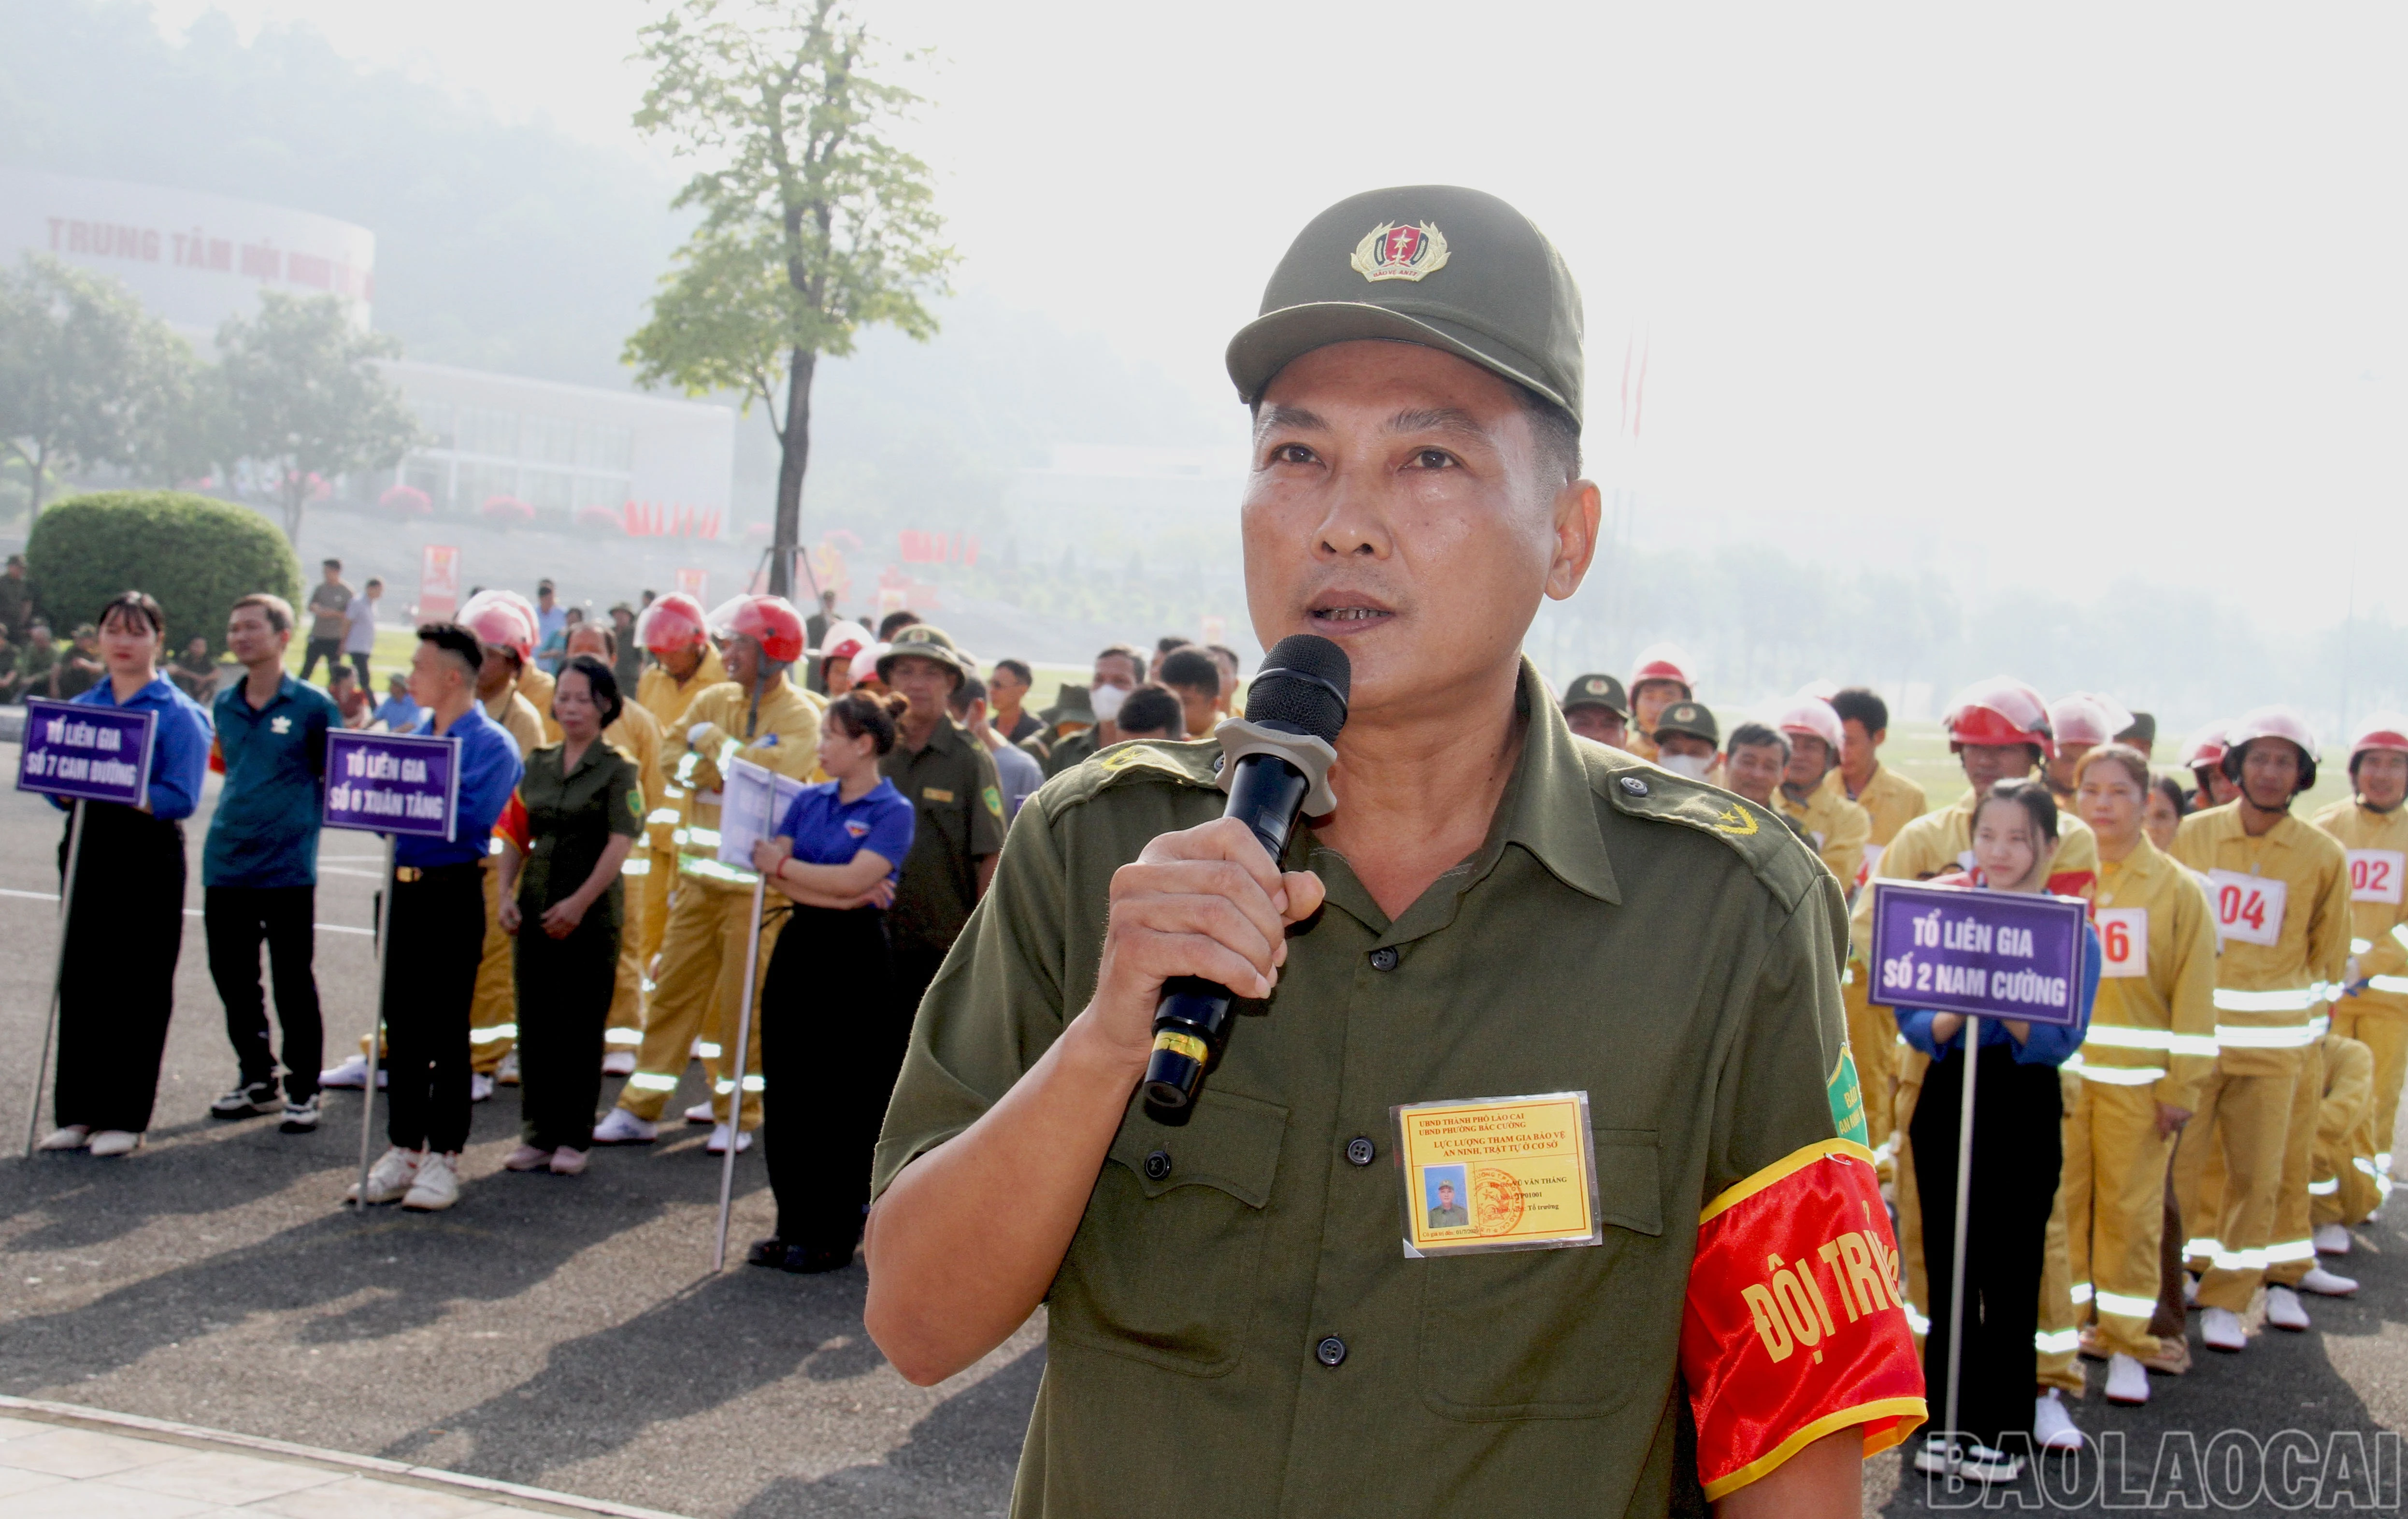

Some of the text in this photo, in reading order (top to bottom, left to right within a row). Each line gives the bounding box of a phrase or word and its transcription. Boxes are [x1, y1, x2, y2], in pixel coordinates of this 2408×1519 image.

[46, 217, 160, 262] TRUNG
[64, 720, 97, 748] LIÊN
[96, 727, 121, 751] GIA
[26, 746, 48, 775] SỐ
[46, 755, 58, 776] 7
[57, 756, 90, 780] CAM
[366, 751, 400, 781] LIÊN
[401, 758, 427, 783] GIA
[330, 780, 351, 811] SỐ
[363, 788, 404, 816] XUÂN
[2351, 860, 2390, 891] 02
[2219, 885, 2265, 930] 04
[1913, 908, 2034, 958] TỔ LIÊN GIA
[1883, 951, 2067, 1007] SỐ 2 NAM CƯỜNG
[1443, 1125, 1476, 1134] PHƯỜNG
[1497, 1121, 1526, 1130] CƯỜNG
[1473, 1114, 1489, 1123] PHỐ
[1454, 1137, 1485, 1147] LƯỢNG
[1489, 1135, 1513, 1144] THAM
[1553, 1131, 1565, 1139] VỆ
[1458, 1147, 1481, 1155] NINH,
[1484, 1146, 1506, 1154] TRẬT
[1509, 1144, 1521, 1152] TỰ
[1532, 1142, 1545, 1150] CƠ
[1547, 1140, 1558, 1148] SỞ
[1741, 1253, 1835, 1364] ĐỘI
